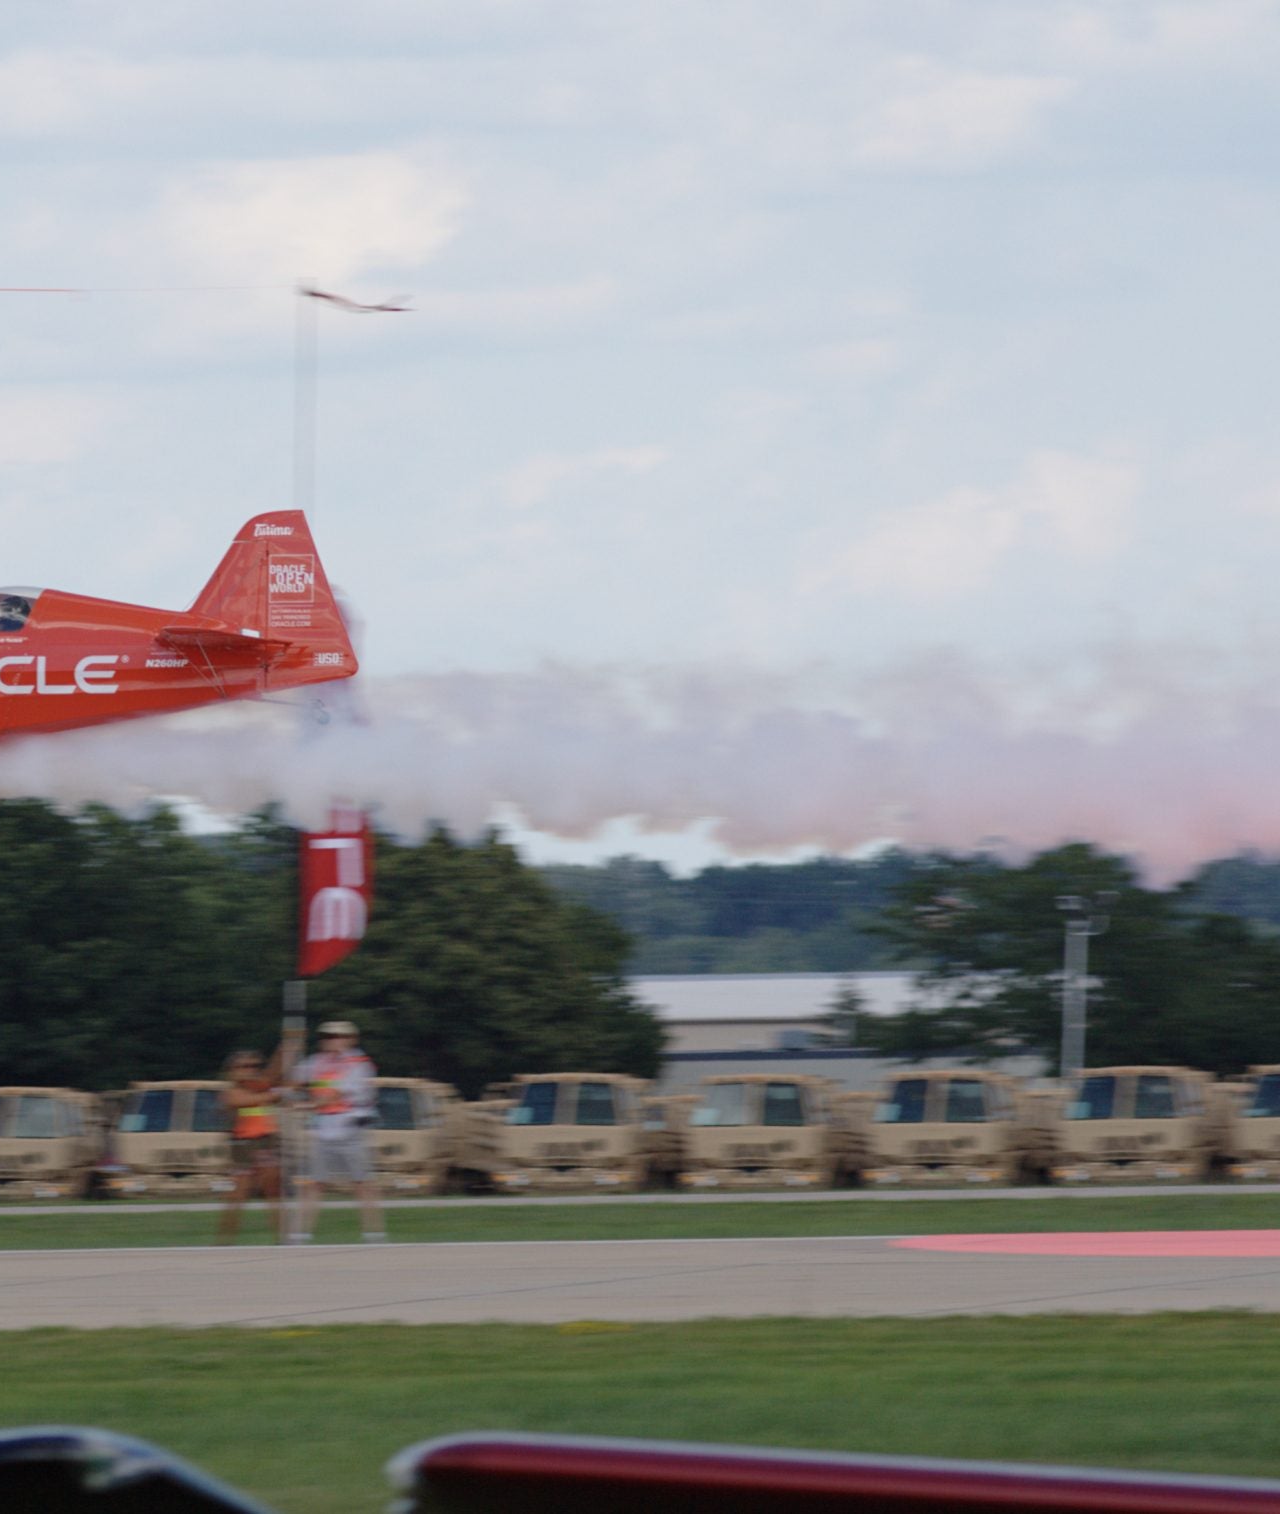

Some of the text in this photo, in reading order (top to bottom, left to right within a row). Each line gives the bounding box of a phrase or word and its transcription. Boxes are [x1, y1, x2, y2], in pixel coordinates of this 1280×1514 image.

[269, 564, 306, 574] ORACLE
[276, 572, 314, 585] OPEN
[269, 584, 305, 593] WORLD
[318, 652, 340, 664] USO
[145, 659, 189, 668] N260HP
